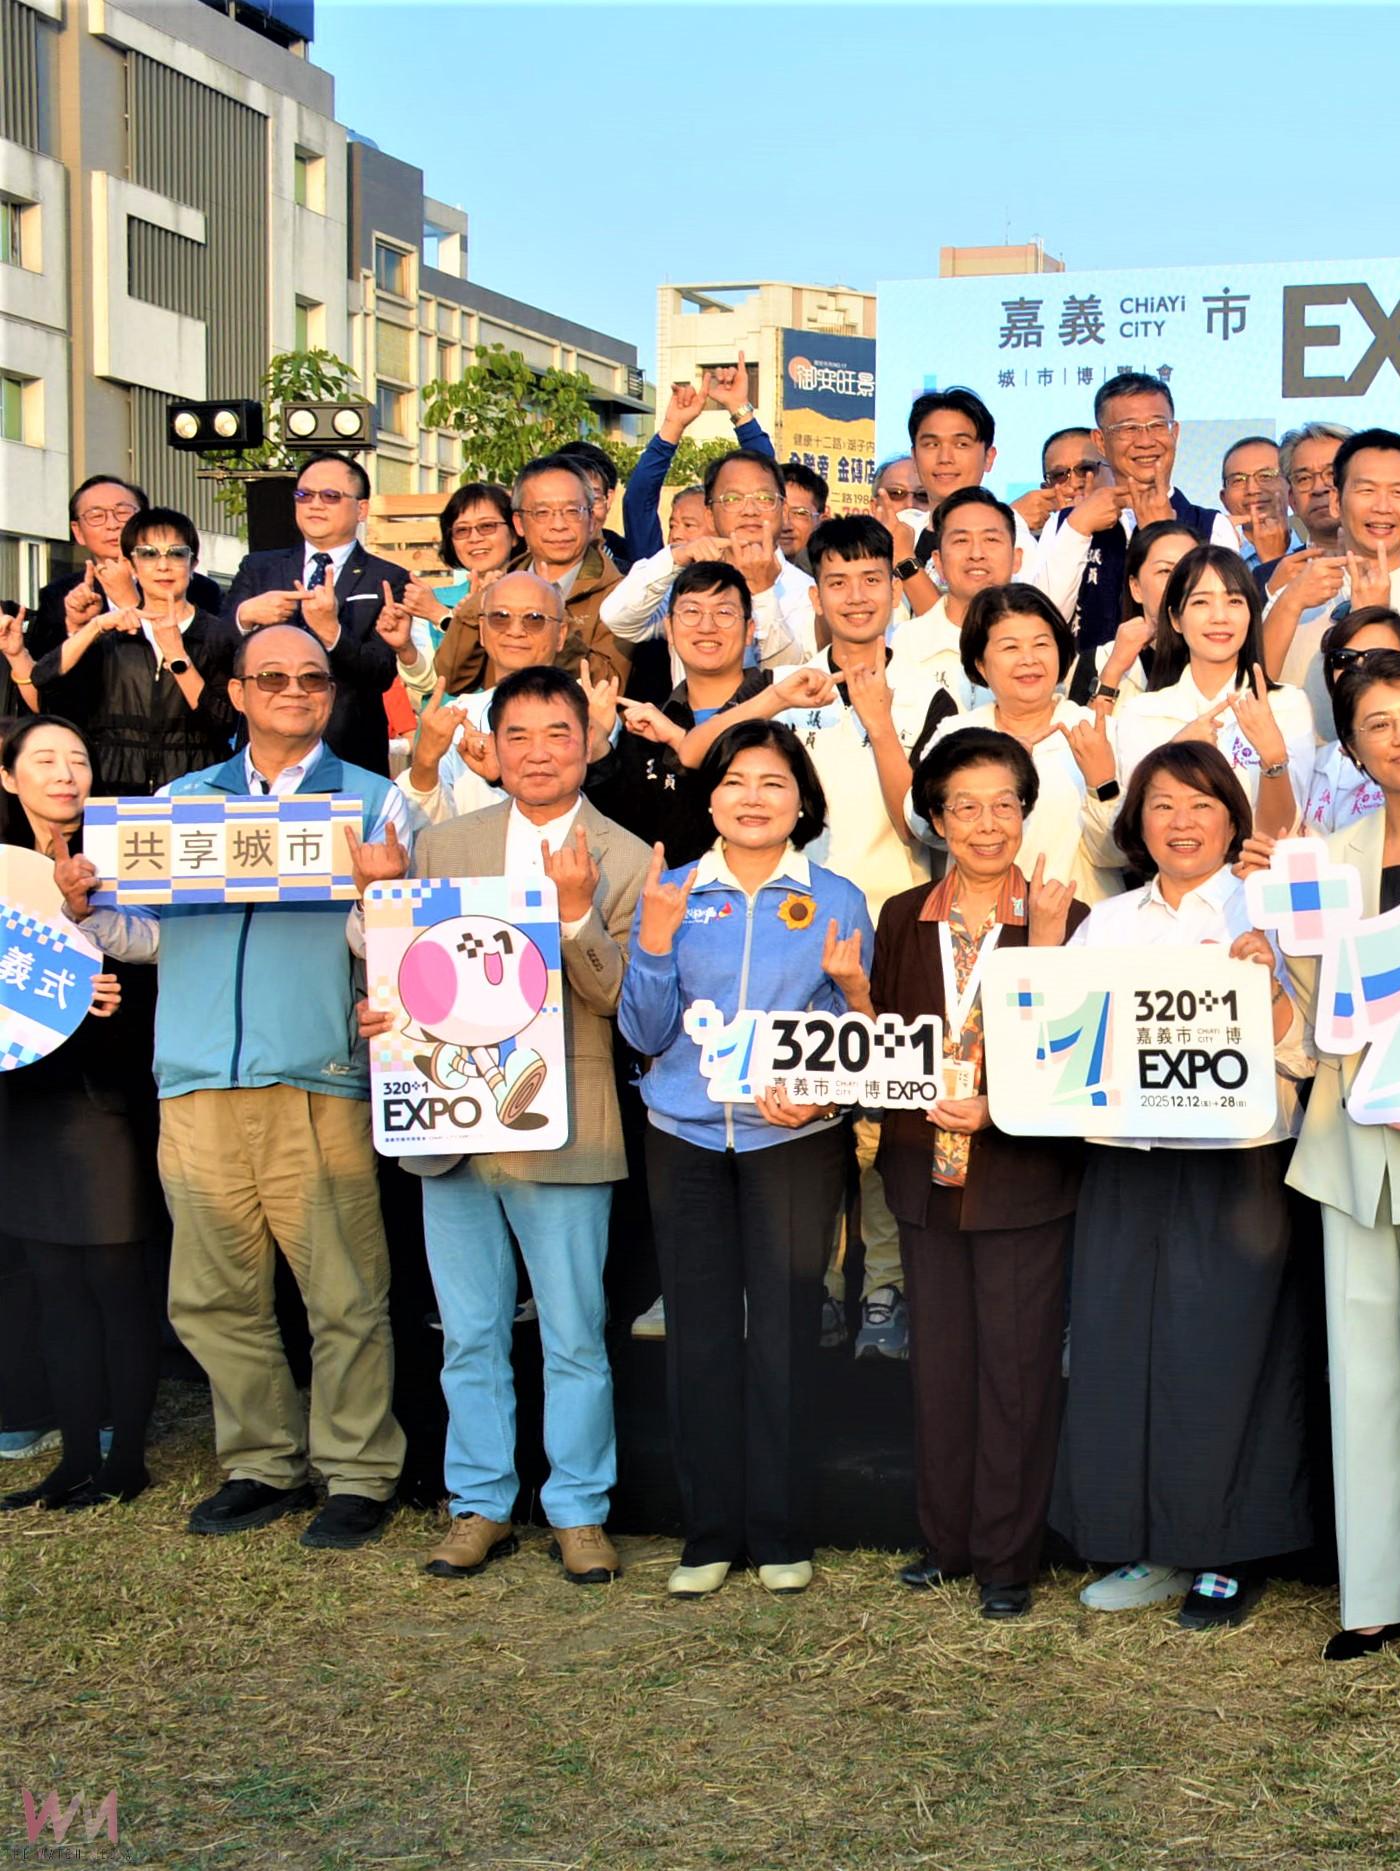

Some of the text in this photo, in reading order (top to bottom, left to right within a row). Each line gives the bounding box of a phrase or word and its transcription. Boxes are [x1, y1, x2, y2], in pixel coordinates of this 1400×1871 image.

[1202, 286, 1250, 341] 市
[123, 828, 324, 871] 共享城市
[1138, 1048, 1250, 1090] EXPO
[887, 1080, 938, 1101] EXPO
[383, 1096, 483, 1132] EXPO
